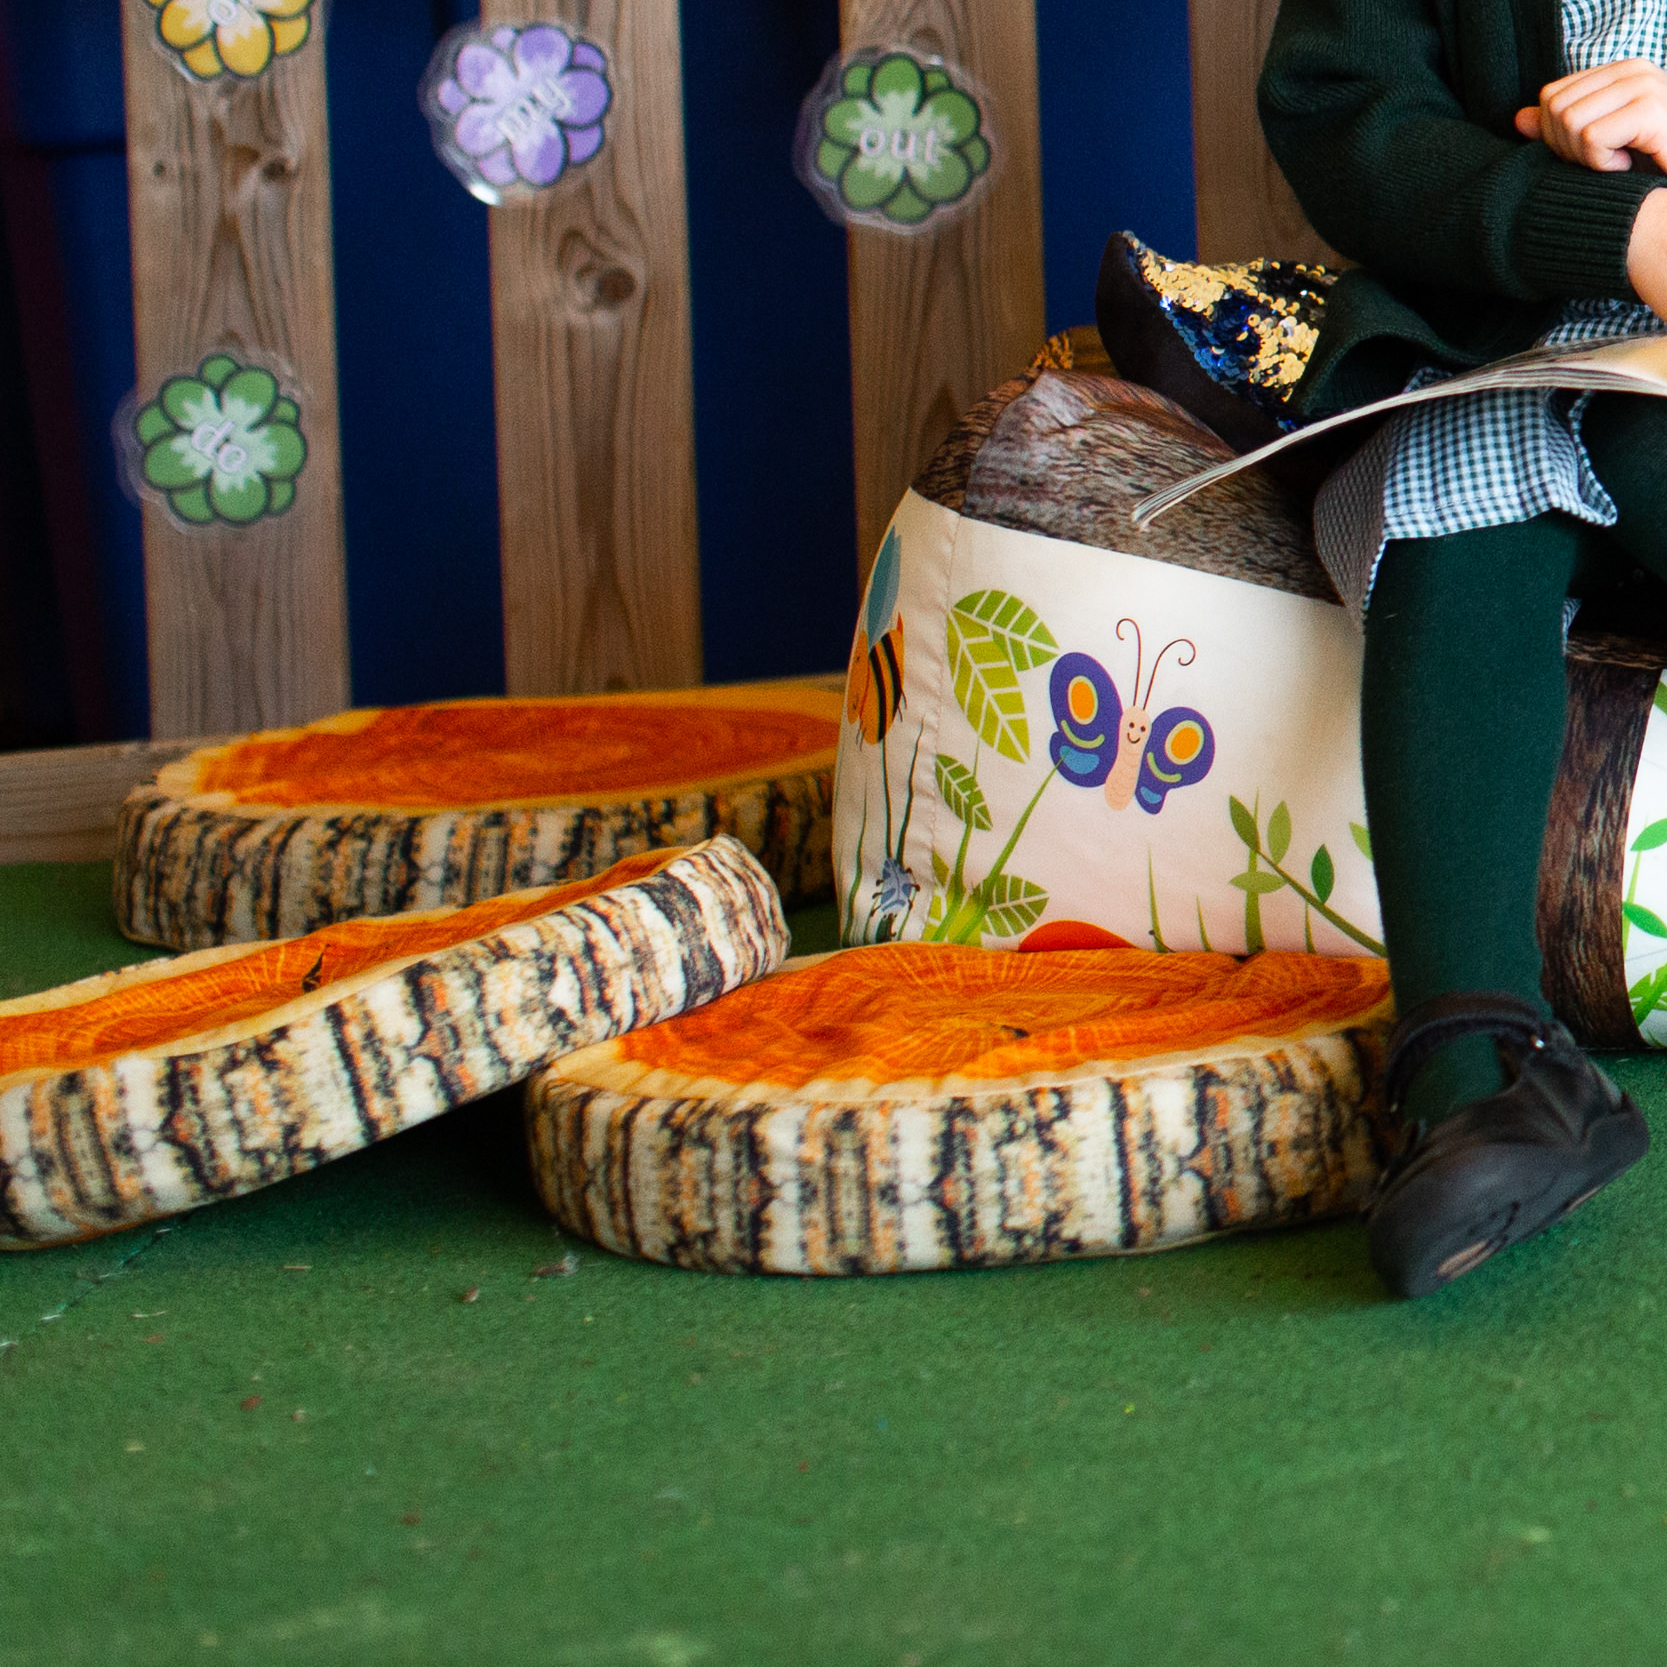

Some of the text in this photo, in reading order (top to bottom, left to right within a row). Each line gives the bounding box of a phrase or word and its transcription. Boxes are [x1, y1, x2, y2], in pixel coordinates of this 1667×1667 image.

[497, 78, 572, 138] my
[859, 127, 937, 166] out
[191, 420, 247, 473] do
